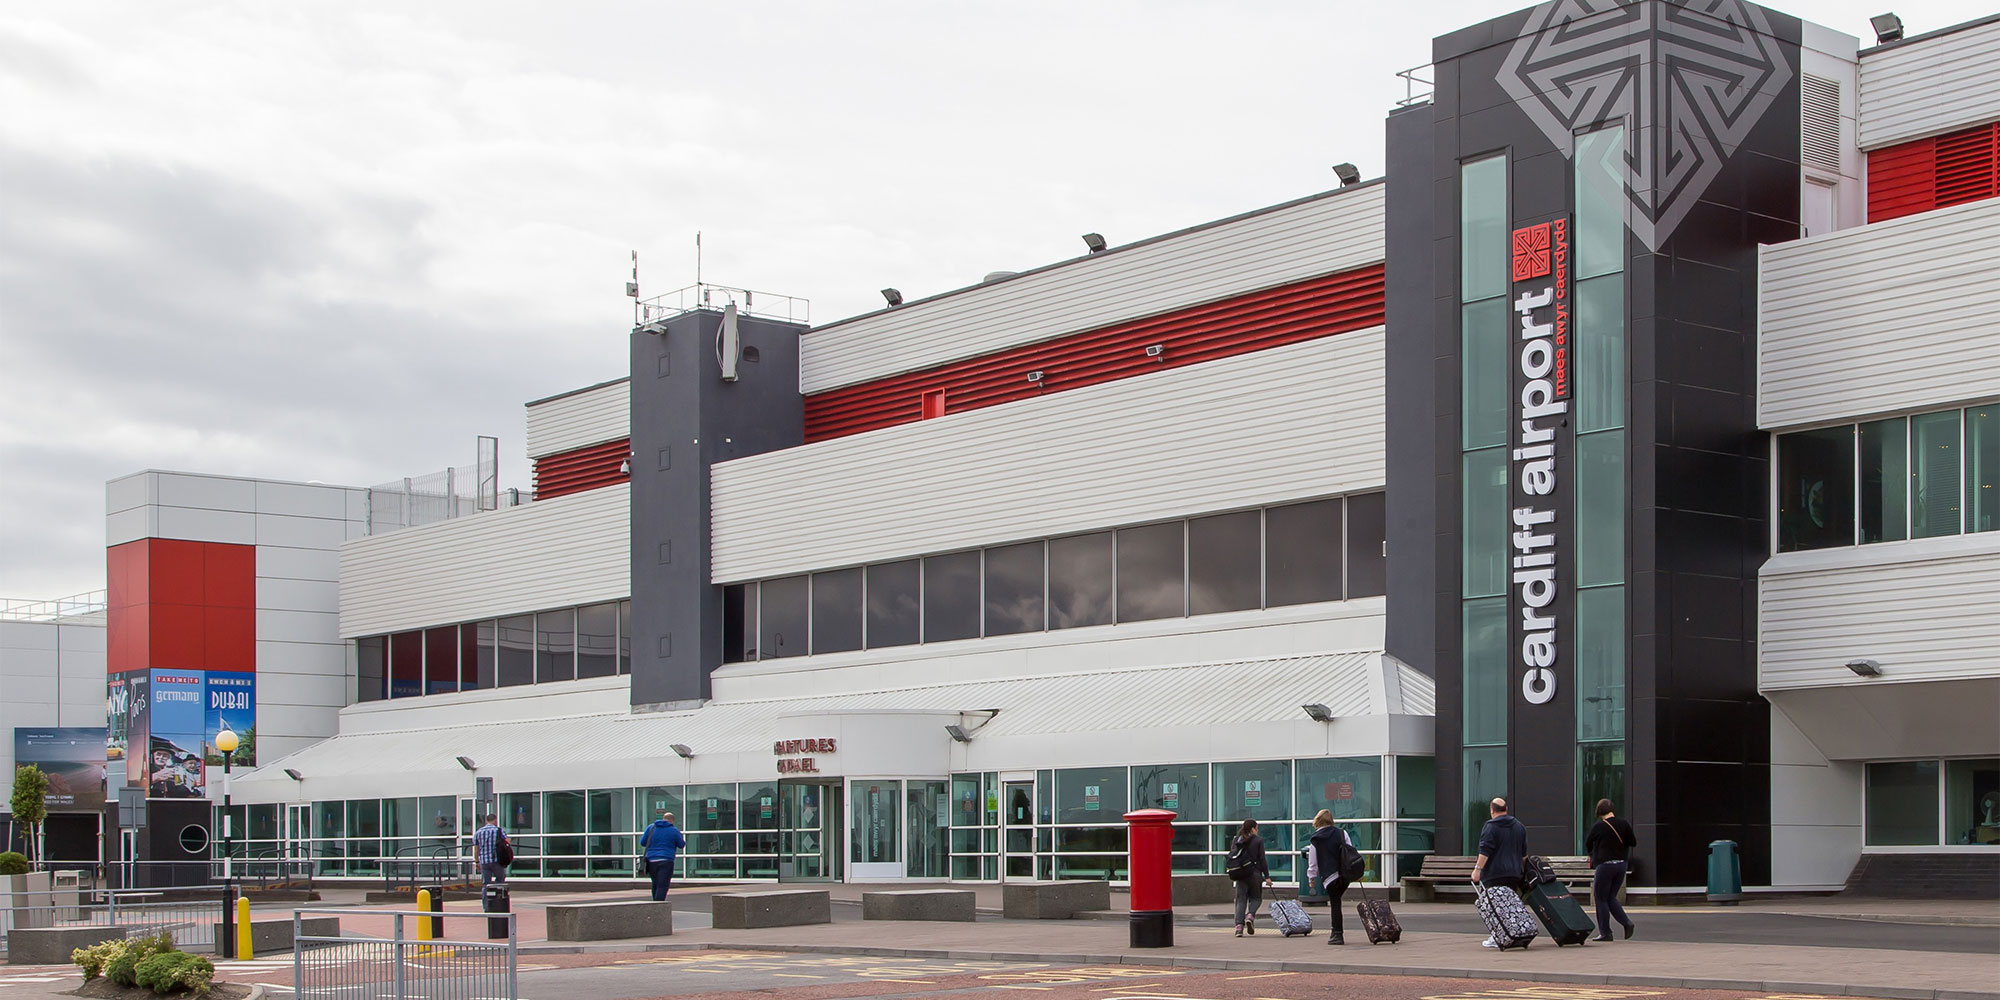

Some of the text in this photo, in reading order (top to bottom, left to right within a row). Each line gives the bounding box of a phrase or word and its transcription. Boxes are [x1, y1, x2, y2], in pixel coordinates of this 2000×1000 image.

[1553, 217, 1569, 397] maes awyr caerdydd
[1512, 286, 1567, 705] cardiff airport
[107, 687, 128, 717] NYC
[211, 690, 249, 710] DUBAI
[977, 967, 1186, 984] BUS
